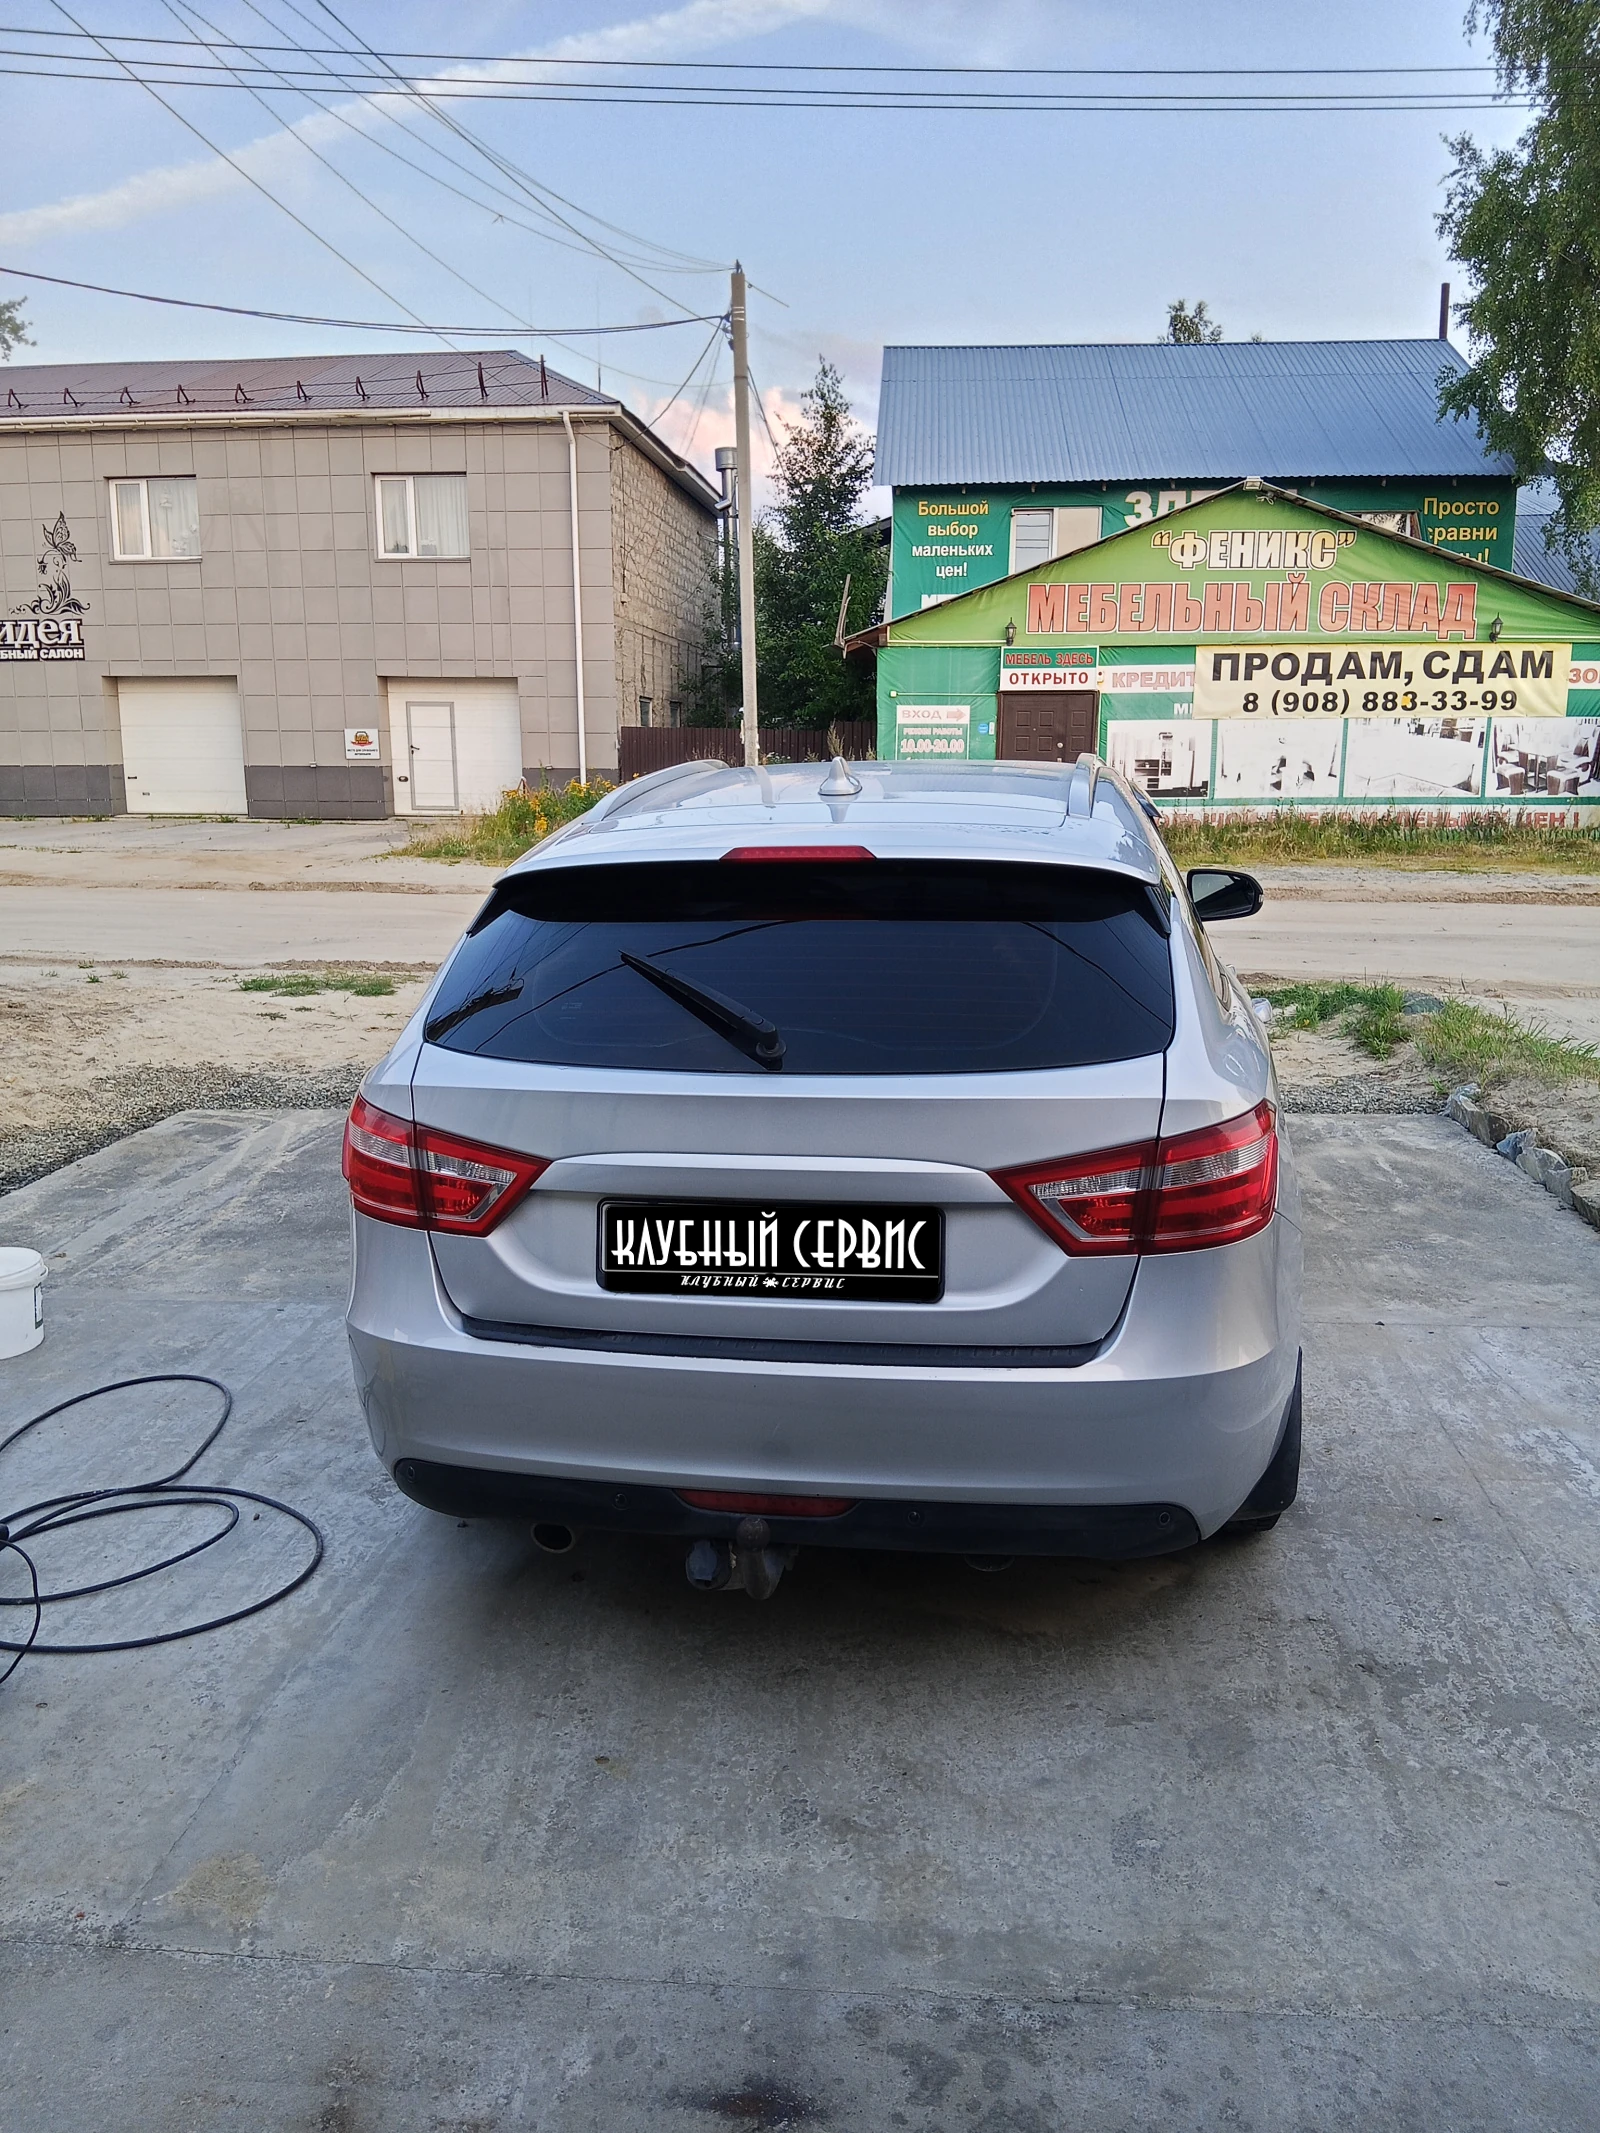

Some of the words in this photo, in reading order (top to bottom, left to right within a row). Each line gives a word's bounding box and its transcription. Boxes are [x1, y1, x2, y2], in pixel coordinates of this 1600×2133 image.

[918, 500, 989, 516] Большой
[1423, 497, 1500, 520] Просто
[927, 521, 979, 539] выбор
[911, 544, 994, 557] маленьких
[935, 562, 968, 579] цен!
[1026, 572, 1310, 634] МЕБЕЛЬНЫЙ
[1317, 580, 1479, 641] СКЛАД
[40, 648, 84, 659] САЛОН
[1005, 653, 1052, 665] МЕБЕЛЬ
[1056, 653, 1094, 666] ЗДЕСЬ
[1211, 650, 1415, 686] ПРОДАМ,
[1422, 650, 1554, 684] СДАМ
[1568, 668, 1600, 684] ЗО
[1009, 672, 1089, 685] ОТКРЫТО
[1112, 671, 1195, 690] КРЕДИТ
[1242, 692, 1259, 713] 8
[1271, 689, 1350, 716] (908)
[1361, 690, 1518, 712] 883-33-99
[902, 709, 942, 720] ВХОД
[611, 1211, 778, 1267] КЛУБНЫЙ
[794, 1218, 927, 1269] СЕРВИС
[680, 1274, 759, 1289] КЛУБНЫЙ
[781, 1277, 846, 1289] СЕРВИС
